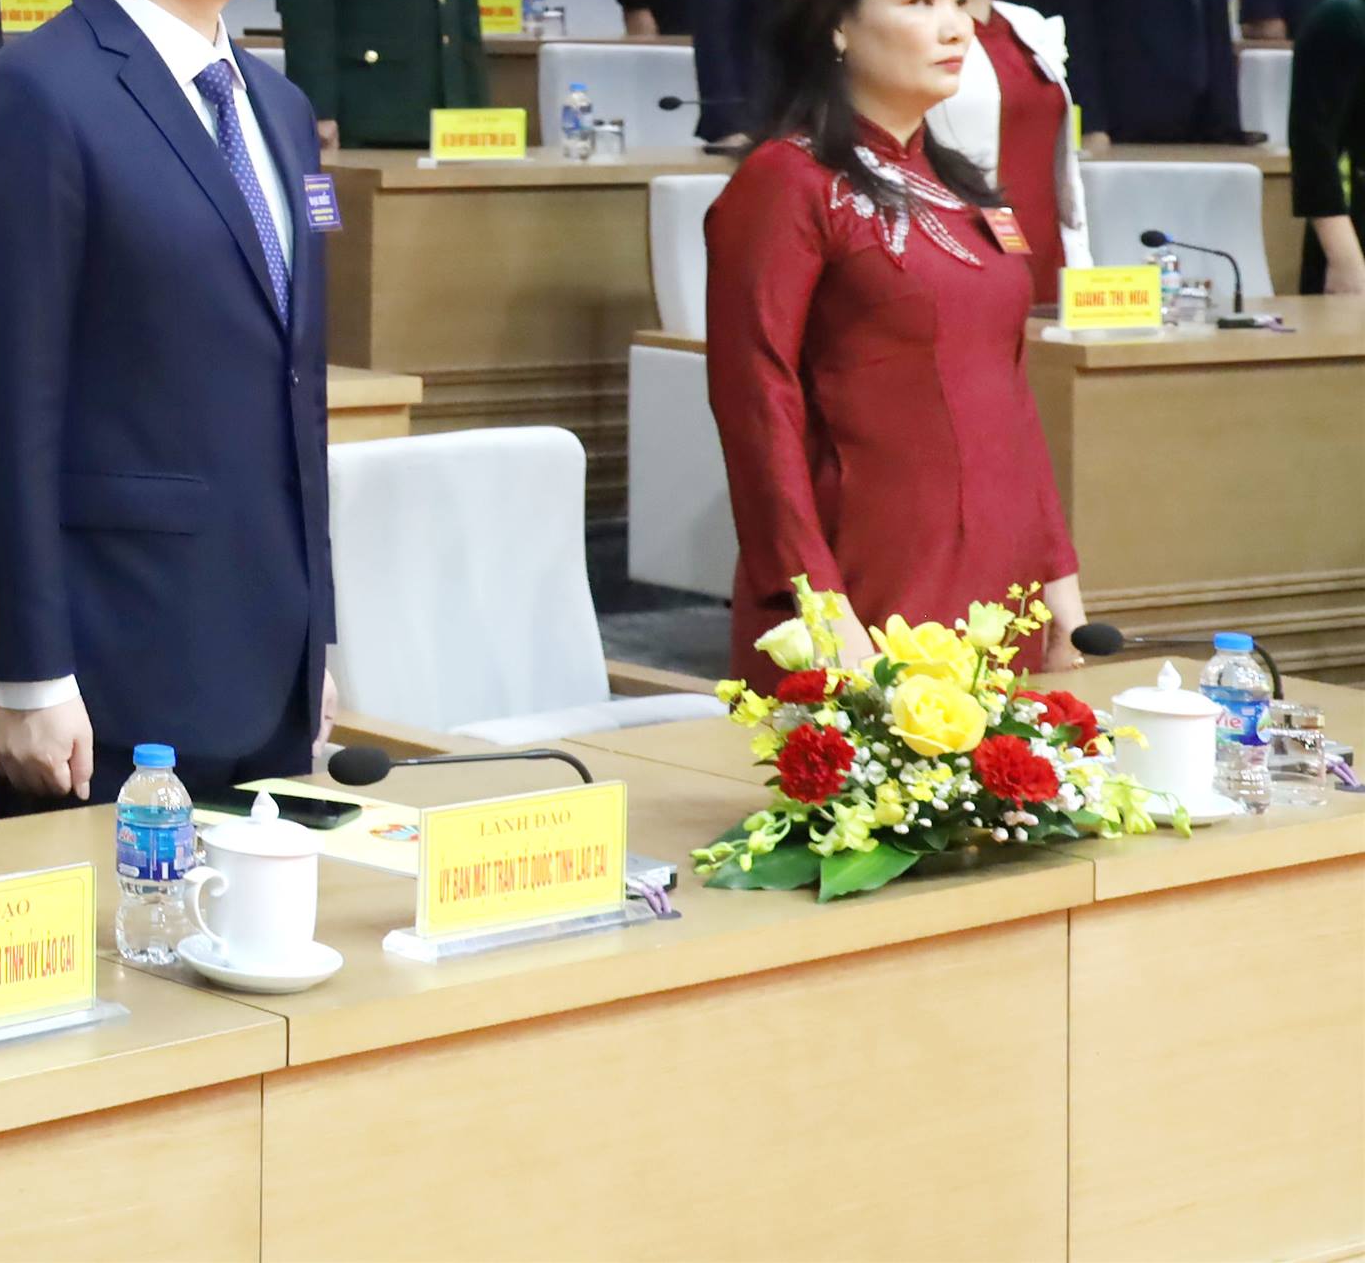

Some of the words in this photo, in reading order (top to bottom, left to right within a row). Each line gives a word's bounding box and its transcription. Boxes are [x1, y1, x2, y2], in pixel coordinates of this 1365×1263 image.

[453, 866, 471, 902] BAN
[5, 930, 25, 985] TỈNH
[41, 930, 58, 978] LÀO
[60, 934, 75, 973] CAI
